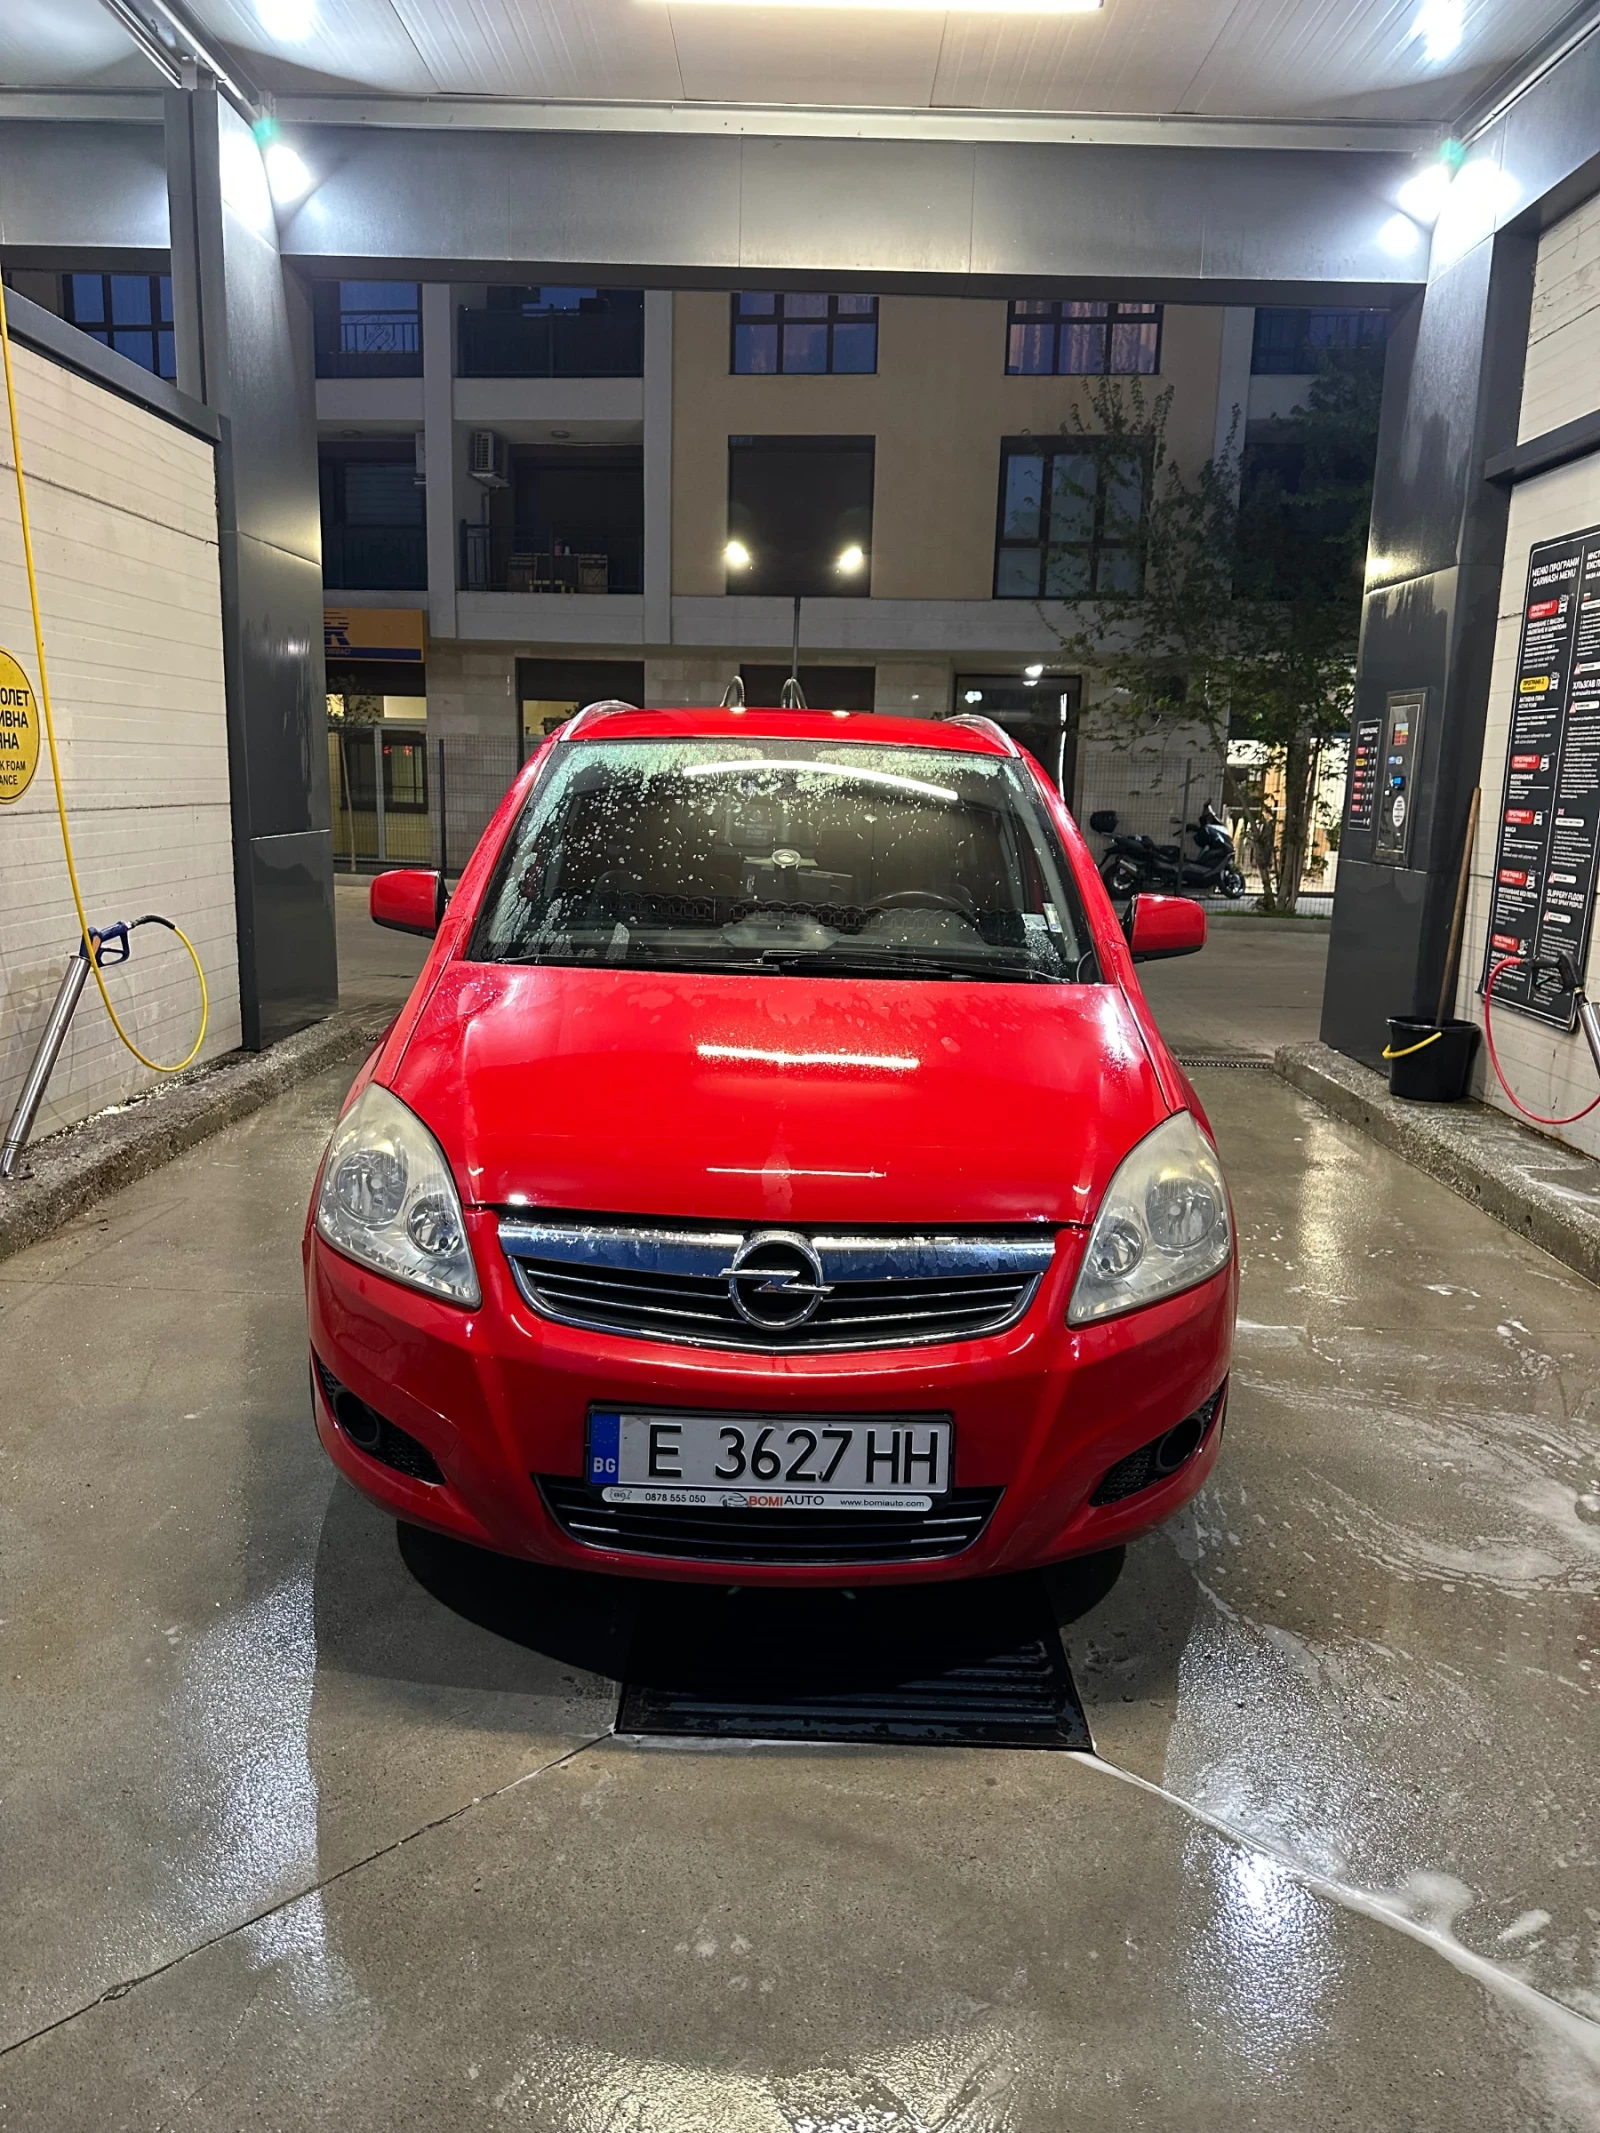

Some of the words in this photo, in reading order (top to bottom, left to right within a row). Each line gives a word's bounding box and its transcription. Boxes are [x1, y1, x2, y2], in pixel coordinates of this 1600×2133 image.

[1532, 565, 1549, 578] МЕНЮ
[1549, 557, 1580, 572] ПРОГРАМИ
[1532, 572, 1559, 587] CARWASH
[1559, 568, 1576, 580] MENU
[6, 760, 26, 770] FOAM
[1547, 889, 1568, 899] SLIPPERY
[1568, 892, 1584, 902] FLOOR!
[649, 1424, 682, 1478] E
[715, 1426, 853, 1482] 3627
[866, 1430, 938, 1484] HH
[593, 1457, 616, 1473] BG
[645, 1492, 668, 1502] 0878
[670, 1494, 686, 1502] 555
[689, 1495, 706, 1503] 050
[840, 1499, 924, 1507] www.bomiauto.com
